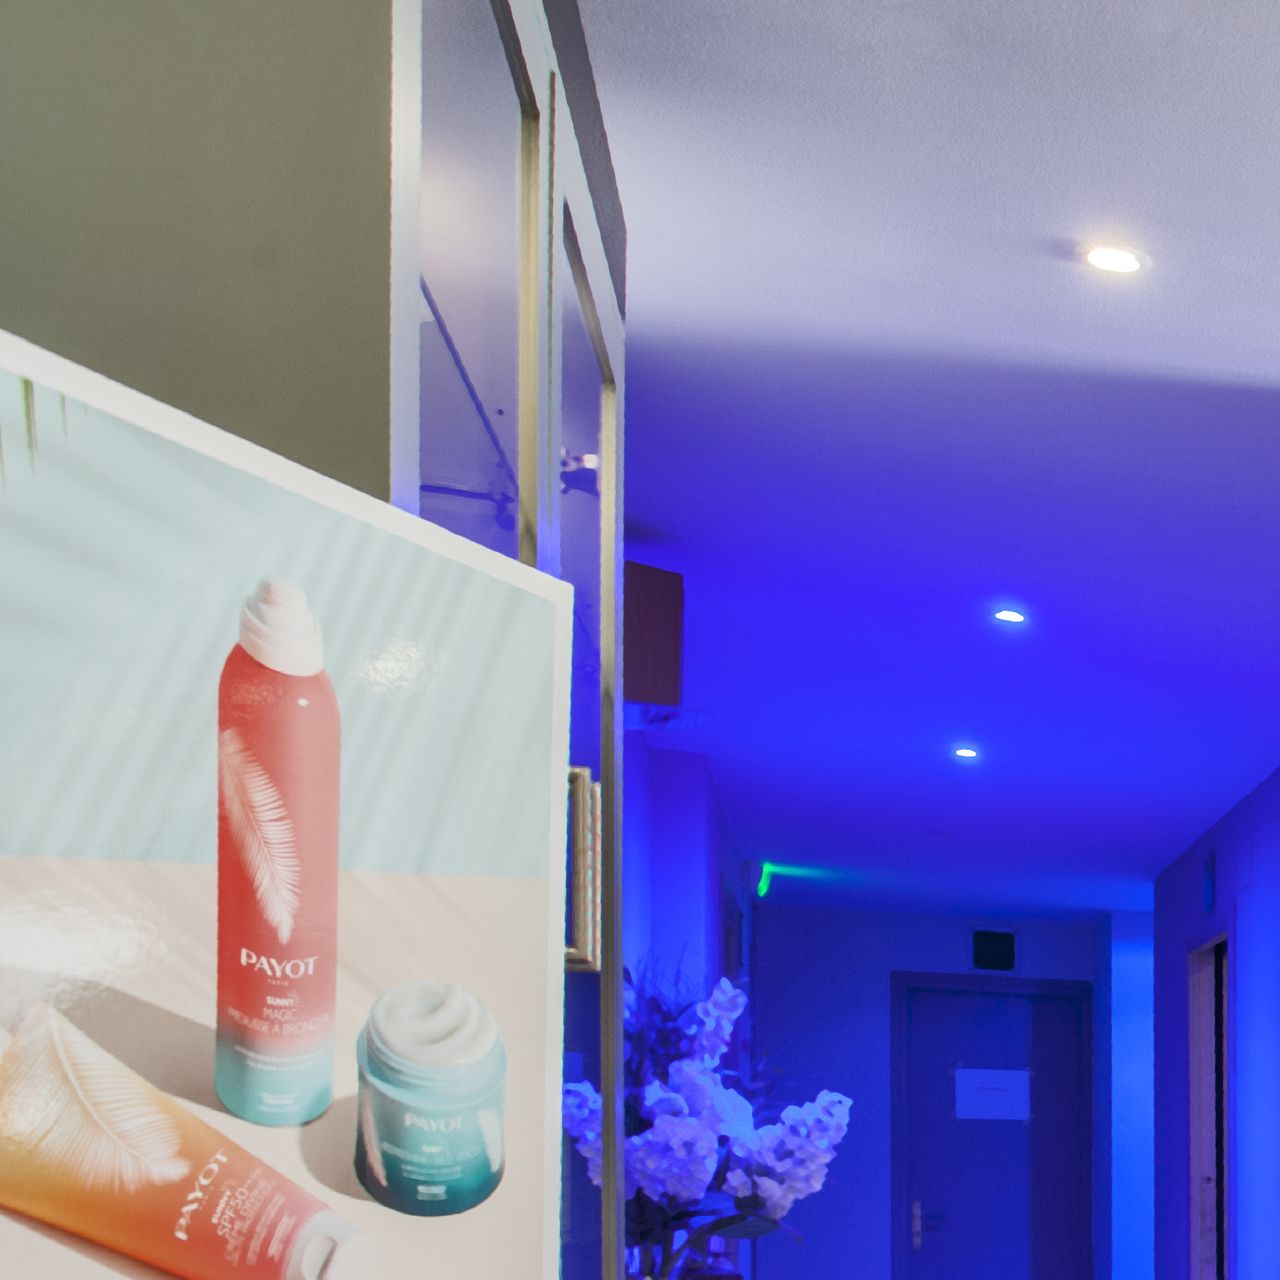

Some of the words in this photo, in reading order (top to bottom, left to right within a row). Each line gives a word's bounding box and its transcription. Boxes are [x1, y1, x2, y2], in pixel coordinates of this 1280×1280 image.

[240, 948, 319, 979] PAYOT
[404, 1112, 462, 1132] PAYOT
[174, 1148, 229, 1241] PAYOT
